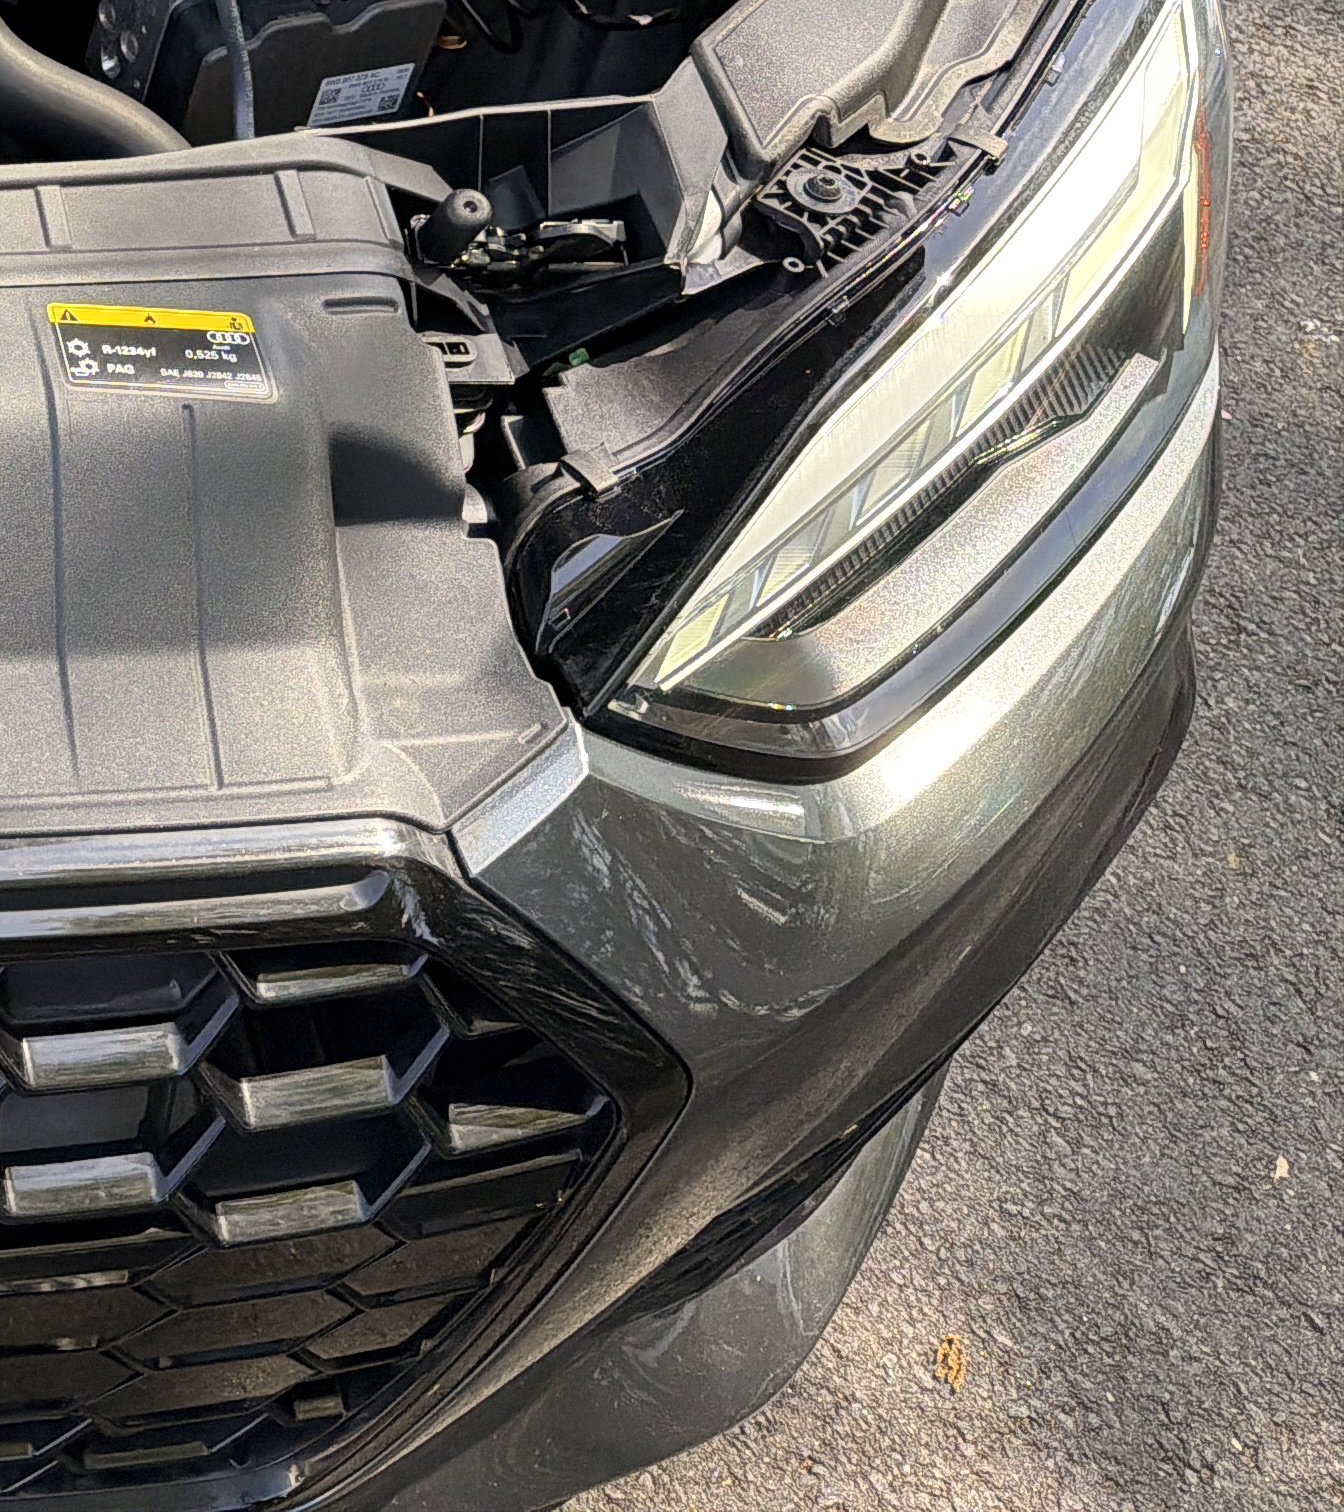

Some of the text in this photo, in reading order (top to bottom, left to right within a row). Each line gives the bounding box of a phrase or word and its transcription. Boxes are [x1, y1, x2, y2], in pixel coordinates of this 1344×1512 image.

[185, 349, 218, 360] 0,525
[221, 350, 238, 363] kg
[106, 363, 136, 375] PAG
